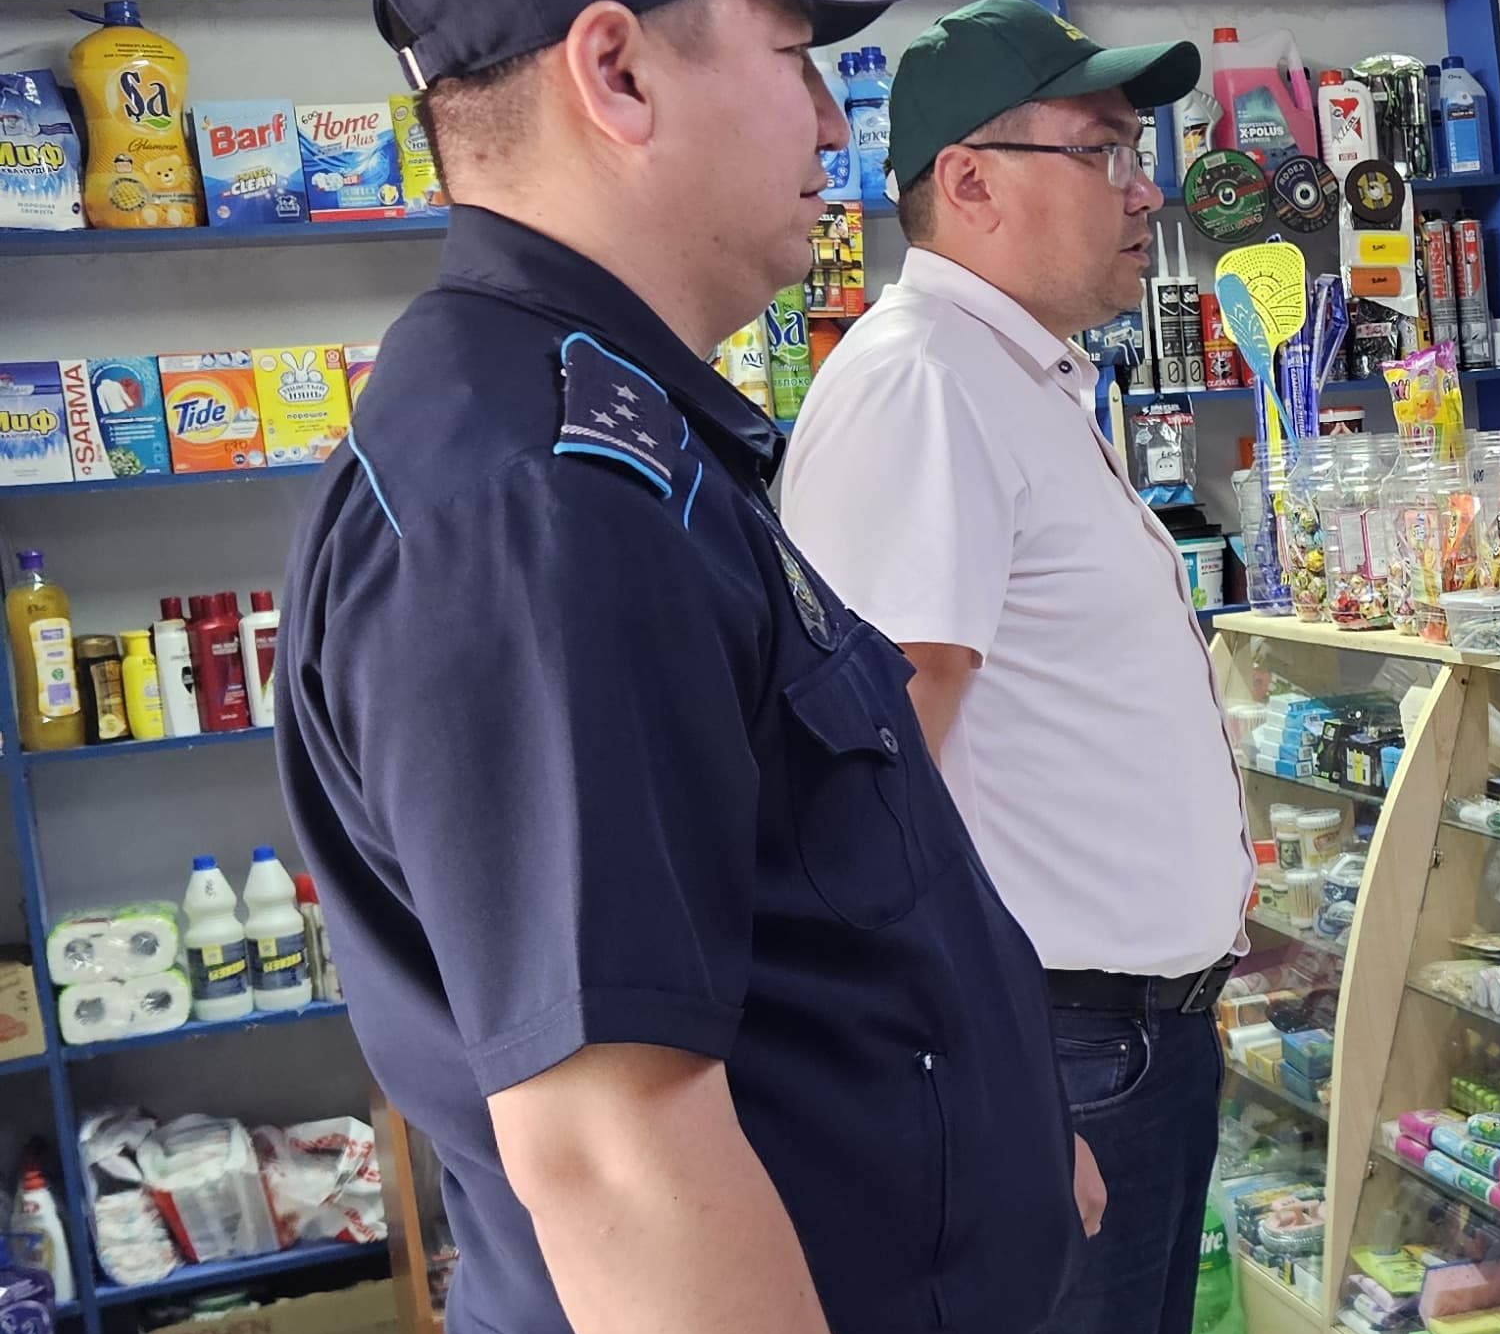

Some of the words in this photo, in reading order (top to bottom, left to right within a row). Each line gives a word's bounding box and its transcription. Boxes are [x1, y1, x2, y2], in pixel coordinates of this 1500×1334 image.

[210, 113, 288, 158] Barf
[313, 111, 380, 141] Home
[345, 133, 376, 149] Plus
[231, 174, 277, 196] CLEAN
[64, 364, 95, 464] SARMA
[172, 399, 226, 436] Tide
